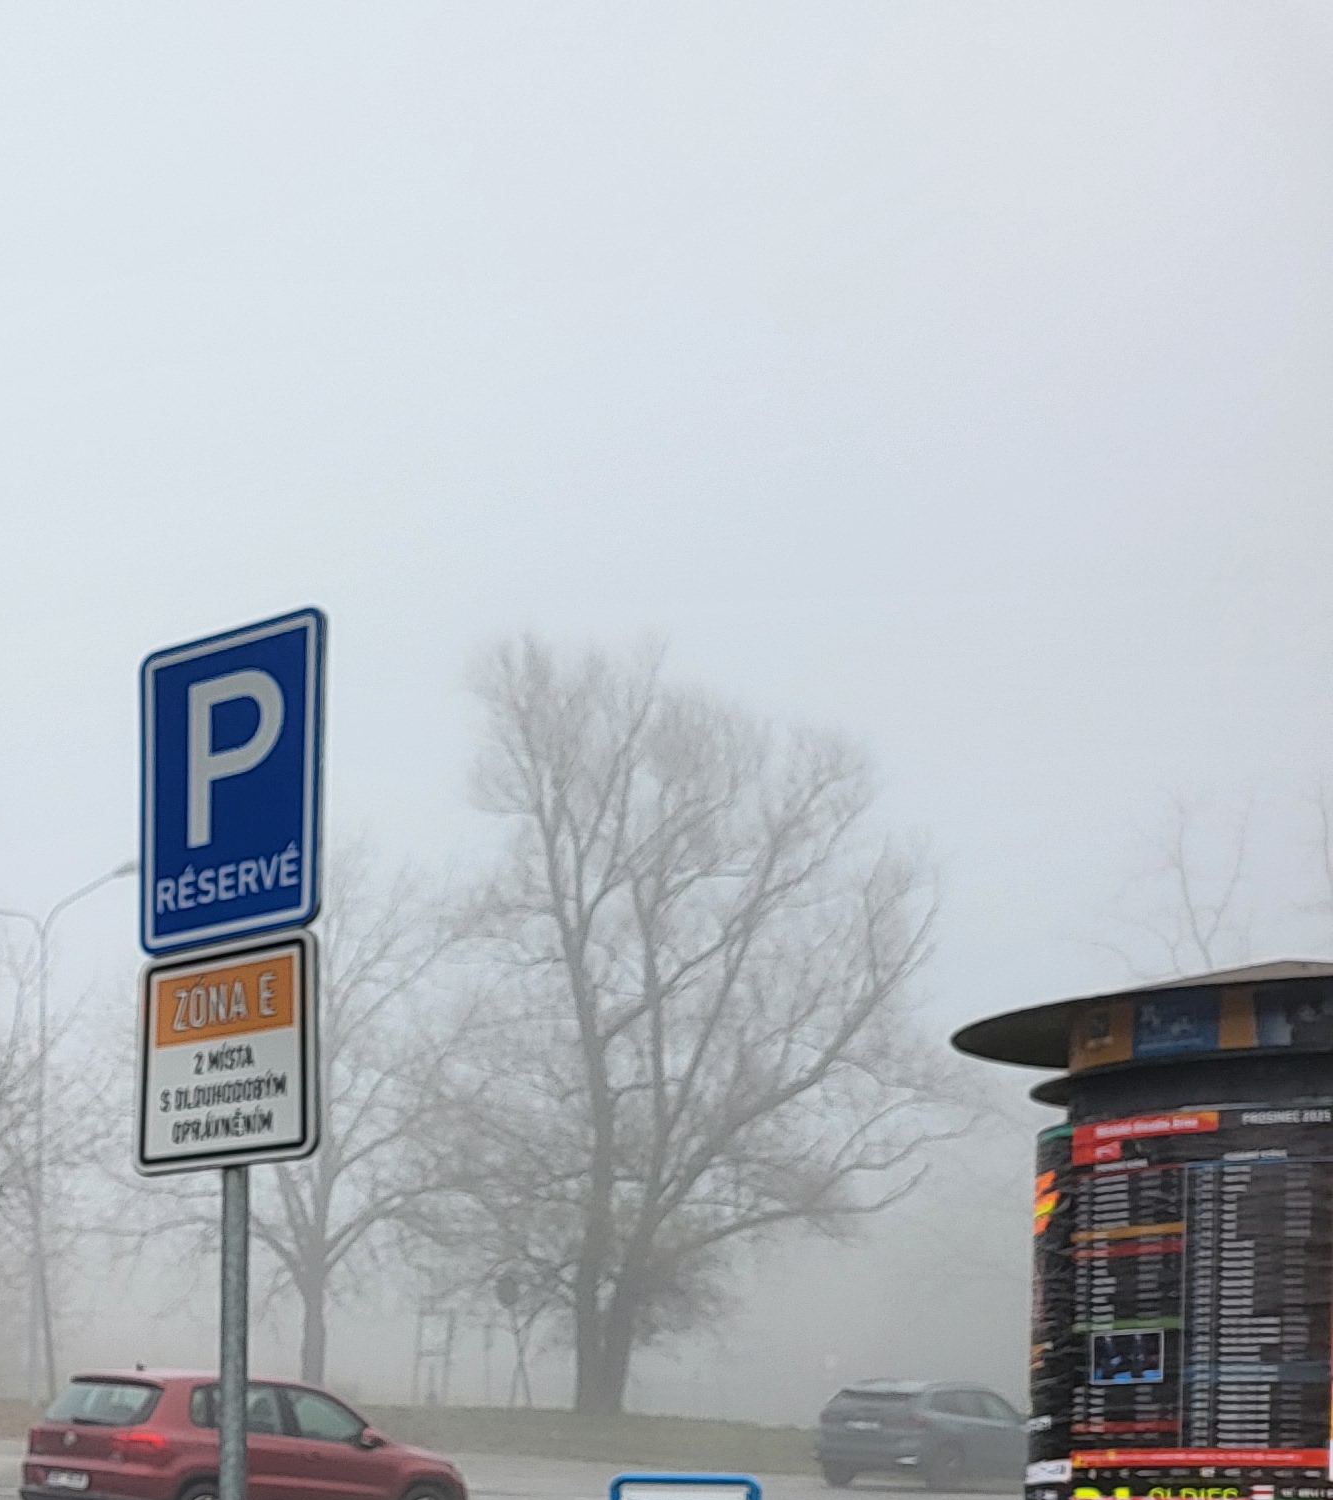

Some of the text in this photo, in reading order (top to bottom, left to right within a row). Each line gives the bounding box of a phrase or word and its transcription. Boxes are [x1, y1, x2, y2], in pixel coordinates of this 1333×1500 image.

[186, 667, 285, 848] P
[156, 840, 300, 914] RÉSERVÉ
[172, 970, 278, 1033] ZÓNA E
[193, 1041, 255, 1075] 2 MÍSTA
[159, 1088, 171, 1112] S
